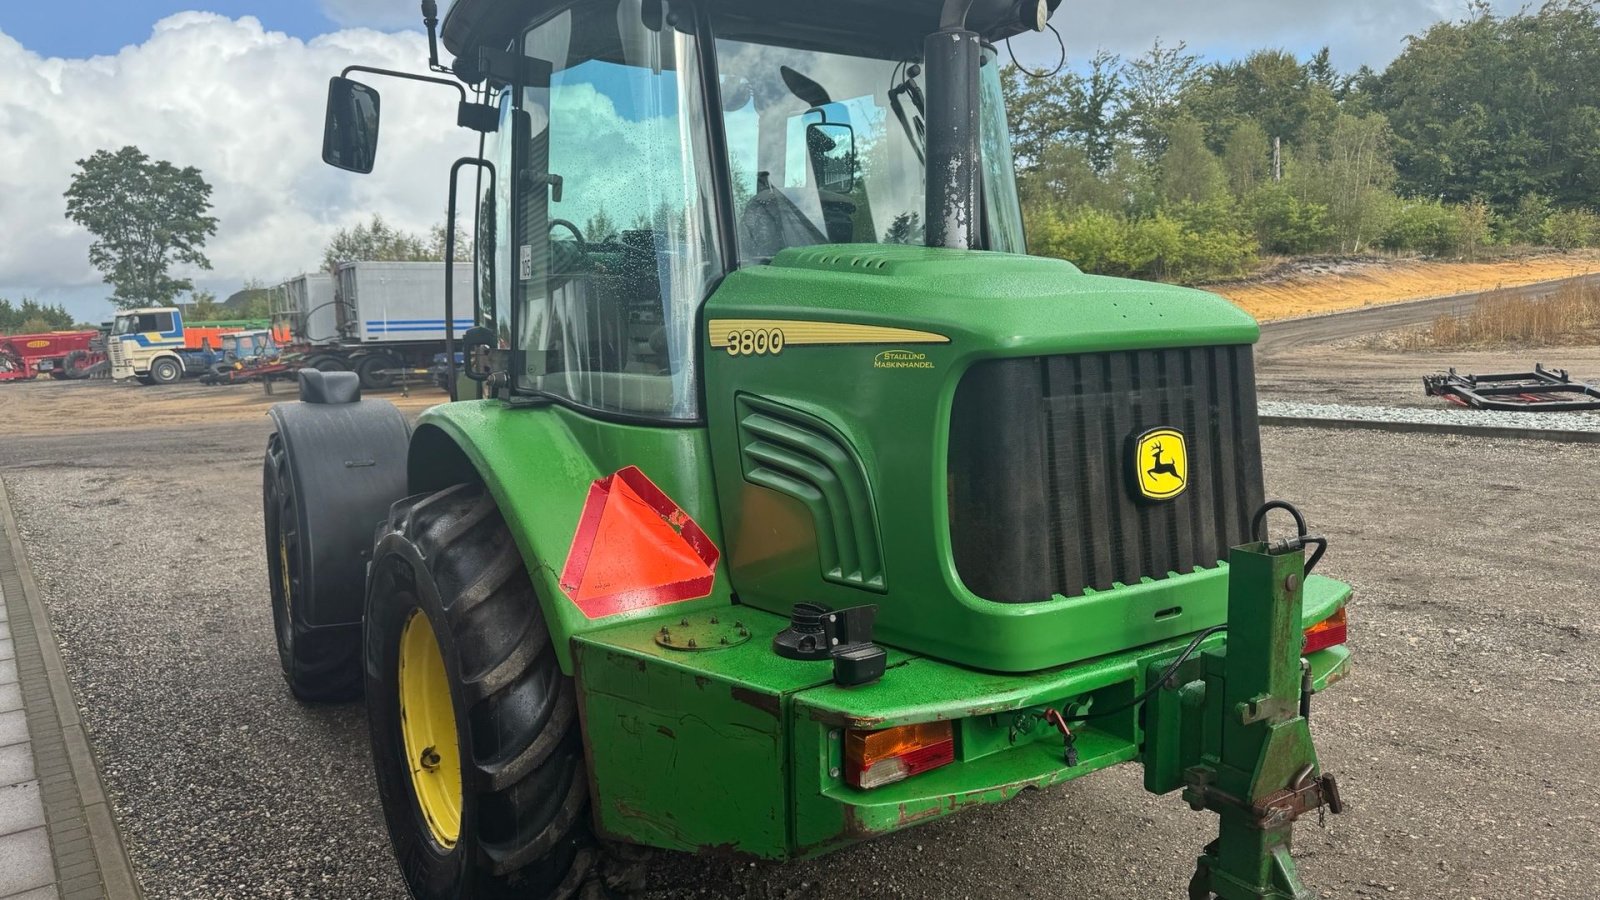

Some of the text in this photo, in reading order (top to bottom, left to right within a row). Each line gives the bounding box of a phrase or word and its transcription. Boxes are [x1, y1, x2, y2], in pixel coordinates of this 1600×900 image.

[727, 328, 784, 356] 3800
[883, 352, 926, 360] STAULUND
[873, 361, 935, 369] MASKINHANDEL
